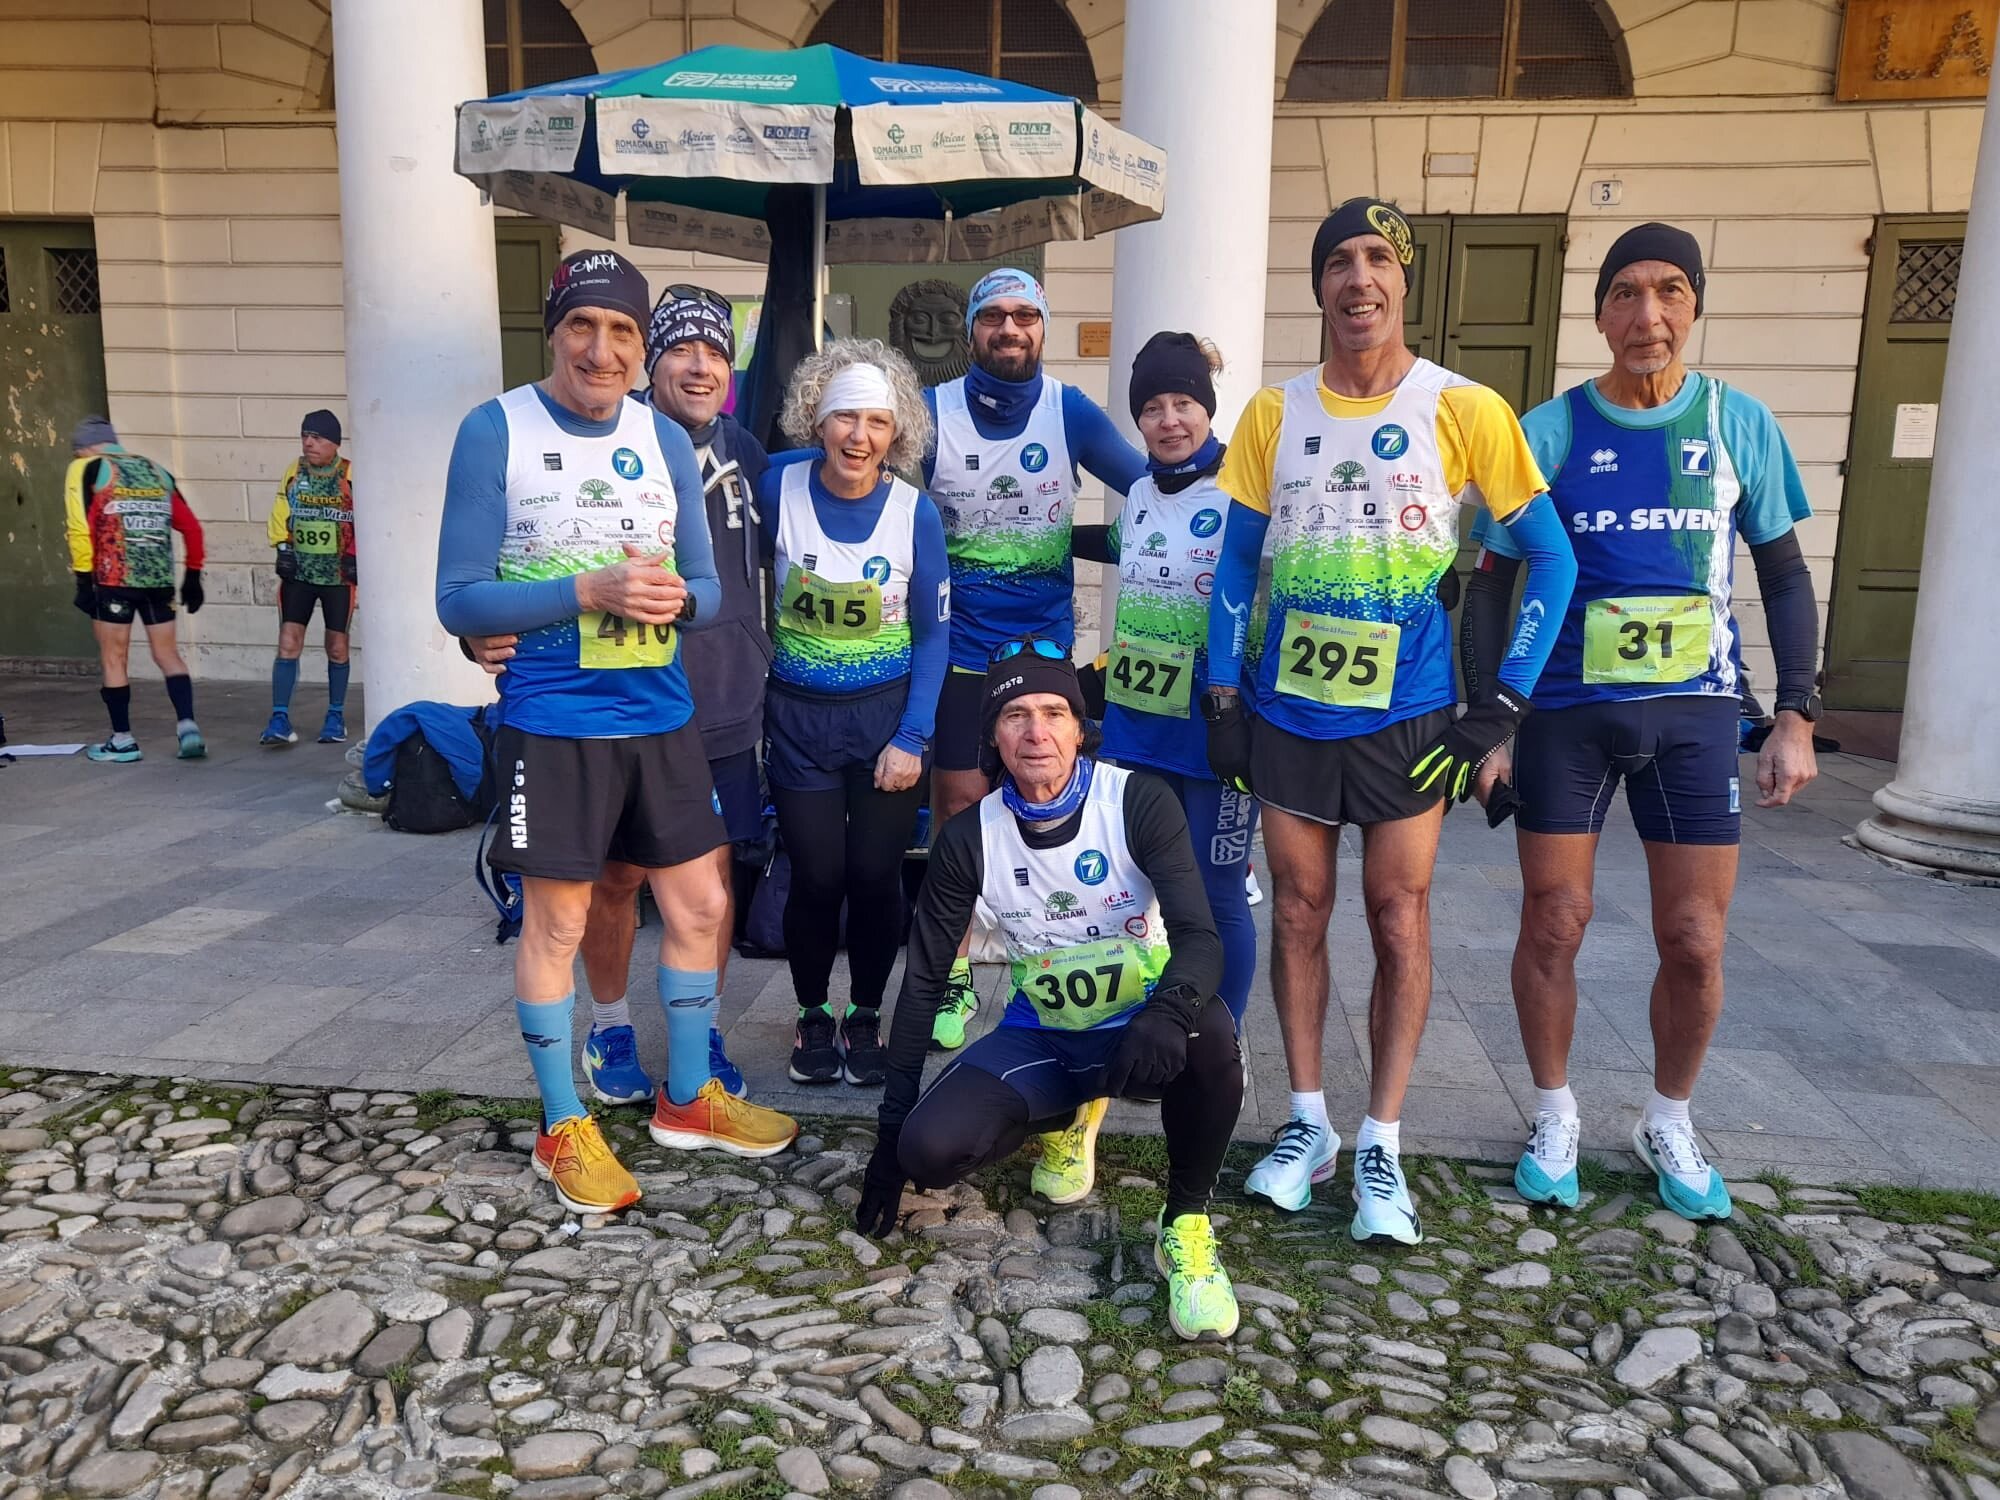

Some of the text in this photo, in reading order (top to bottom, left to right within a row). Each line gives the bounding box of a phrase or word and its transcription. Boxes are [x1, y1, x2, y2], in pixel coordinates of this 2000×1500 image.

[1381, 433, 1400, 451] 7
[619, 456, 635, 473] 7
[1027, 450, 1041, 465] 7
[1683, 445, 1707, 470] 7
[1283, 479, 1311, 490] cactus
[1325, 482, 1369, 492] LEGNAMI
[520, 494, 560, 506] cactus
[946, 489, 975, 498] cactus
[987, 491, 1023, 501] LEGNAMI
[577, 499, 623, 509] LEGNAMI
[1199, 515, 1215, 530] 7
[1573, 508, 1721, 534] S.P. SEVEN
[296, 529, 331, 546] 389
[1138, 549, 1168, 560] LEGNAMI
[868, 564, 883, 580] 7
[792, 591, 867, 628] 415
[1617, 620, 1673, 660] 31
[1290, 635, 1379, 687] 295
[1112, 655, 1182, 698] 427
[510, 793, 528, 849] SEVEN
[1082, 858, 1099, 877] 7
[1001, 909, 1032, 919] cactus
[1045, 908, 1088, 921] LEGNAMI
[1035, 963, 1124, 1010] 307
